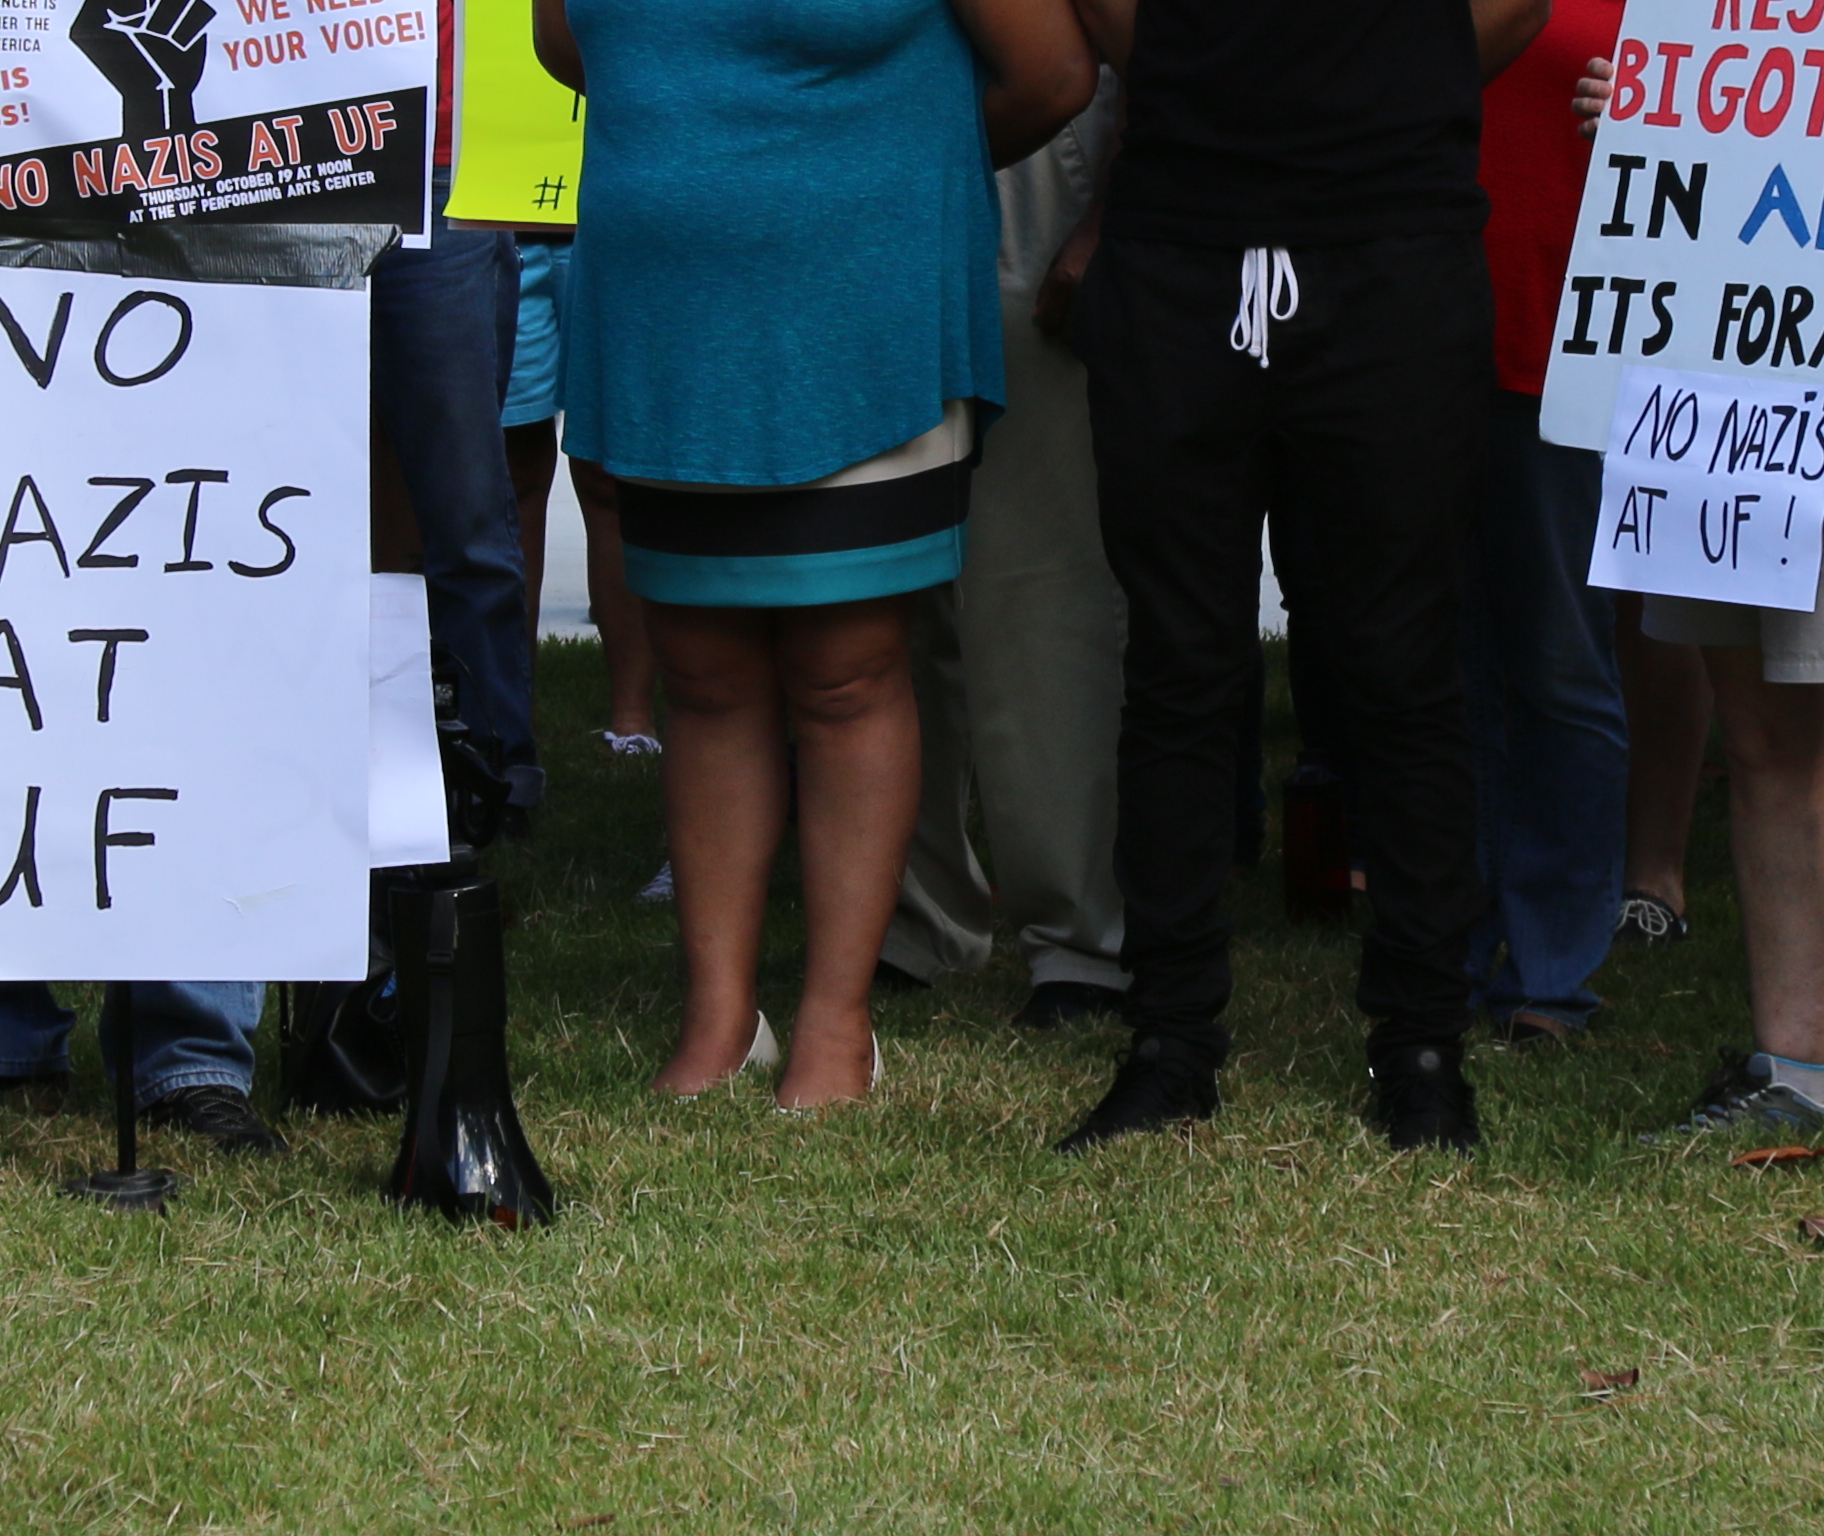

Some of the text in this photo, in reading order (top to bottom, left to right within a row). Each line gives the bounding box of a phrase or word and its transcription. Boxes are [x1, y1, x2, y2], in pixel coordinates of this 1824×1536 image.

[25, 17, 51, 32] THE
[222, 10, 427, 72] YOUR VOICE!
[0, 66, 30, 92] IS
[72, 129, 224, 199] NAZIS
[247, 114, 304, 173] AT
[326, 100, 398, 156] UF
[216, 170, 274, 194] OCTOBER
[277, 167, 293, 184] 19
[295, 163, 313, 181] AT
[317, 157, 353, 177] NOON
[128, 170, 376, 224] AT THE UF PERFORMING ARTS CENTER
[1599, 153, 1708, 241] IN
[1561, 275, 1678, 357] ITS
[1624, 384, 1699, 462] NO
[1612, 485, 1668, 555] AT
